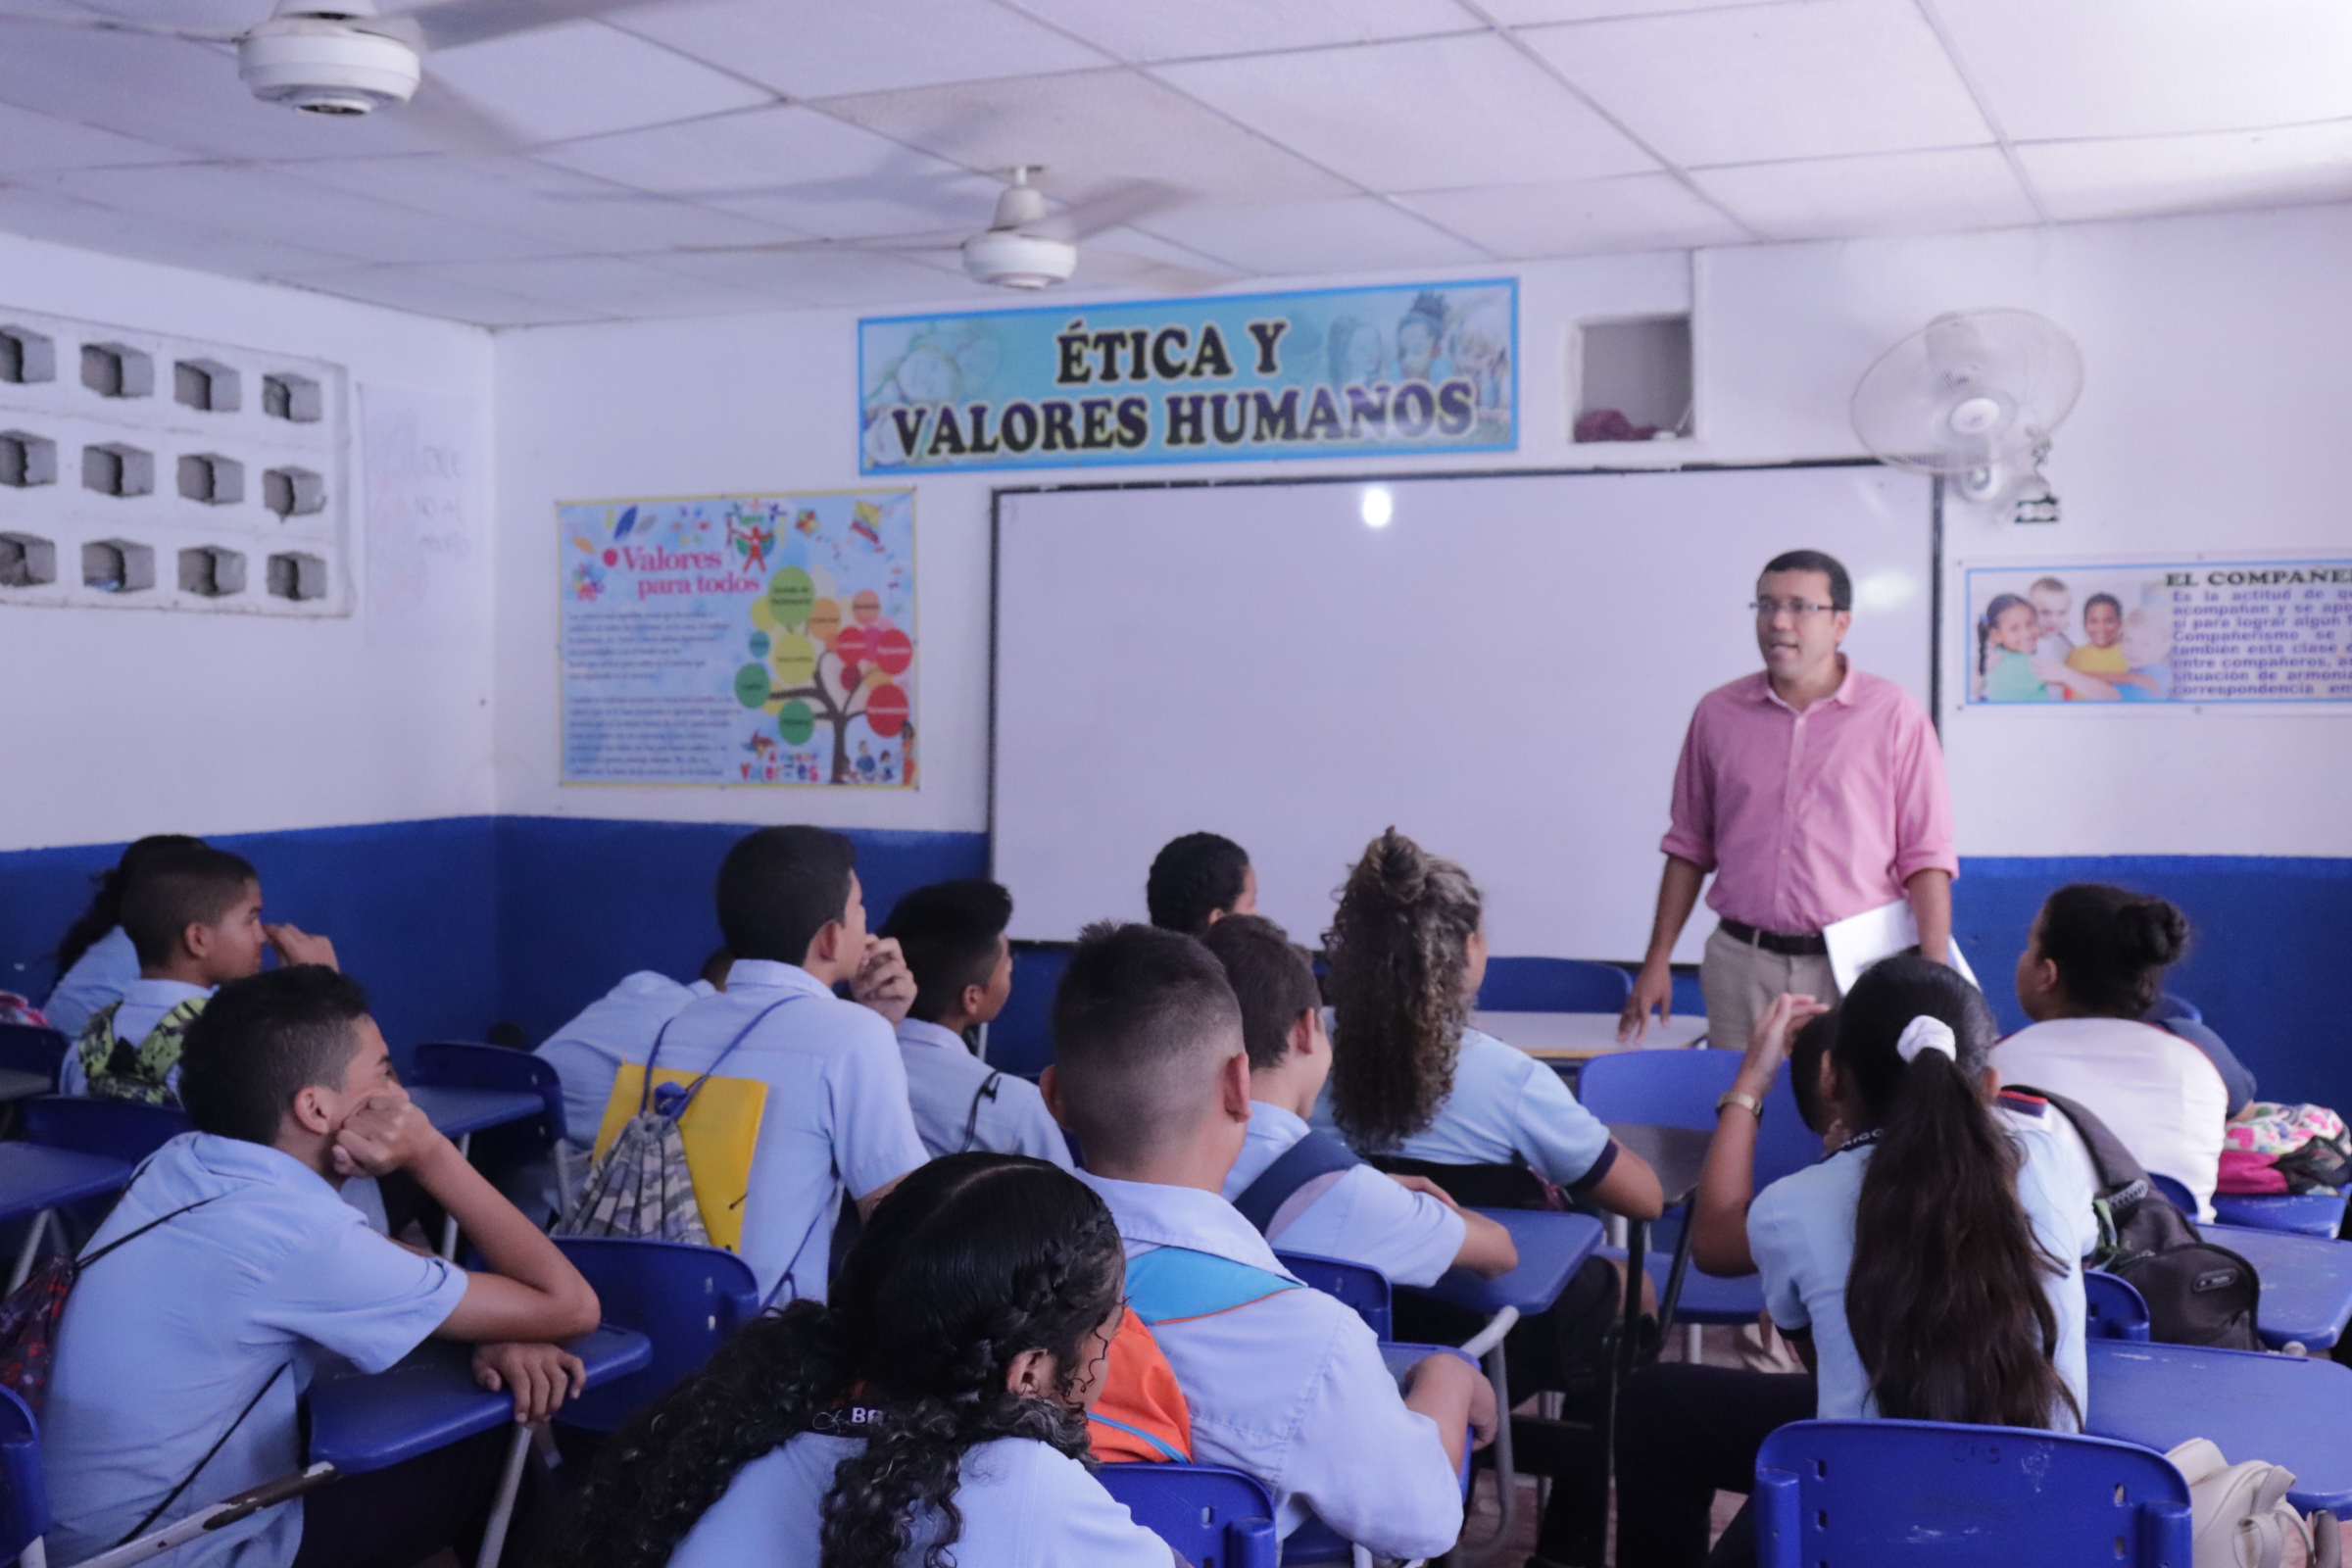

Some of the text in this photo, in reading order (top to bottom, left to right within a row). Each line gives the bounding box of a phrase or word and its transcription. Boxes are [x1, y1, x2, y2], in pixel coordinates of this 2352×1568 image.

[1056, 320, 1288, 384] ÉTICA Y
[892, 380, 1472, 457] VALORES HUMANOS
[622, 545, 722, 571] Valores
[2166, 566, 2352, 586] EL COMPAÑE
[639, 570, 760, 601] para todos
[2205, 589, 2220, 602] la
[2231, 589, 2291, 602] actitud
[2304, 588, 2325, 600] de
[2278, 604, 2286, 616] y
[2294, 604, 2314, 613] se
[2193, 617, 2230, 631] para
[2237, 615, 2287, 630] lograr
[2316, 630, 2335, 640] se
[2247, 643, 2284, 654] esta
[2293, 641, 2338, 654] clase
[2173, 657, 2216, 668] entre
[2258, 669, 2278, 681] de
[2173, 683, 2314, 697] correspondencia
